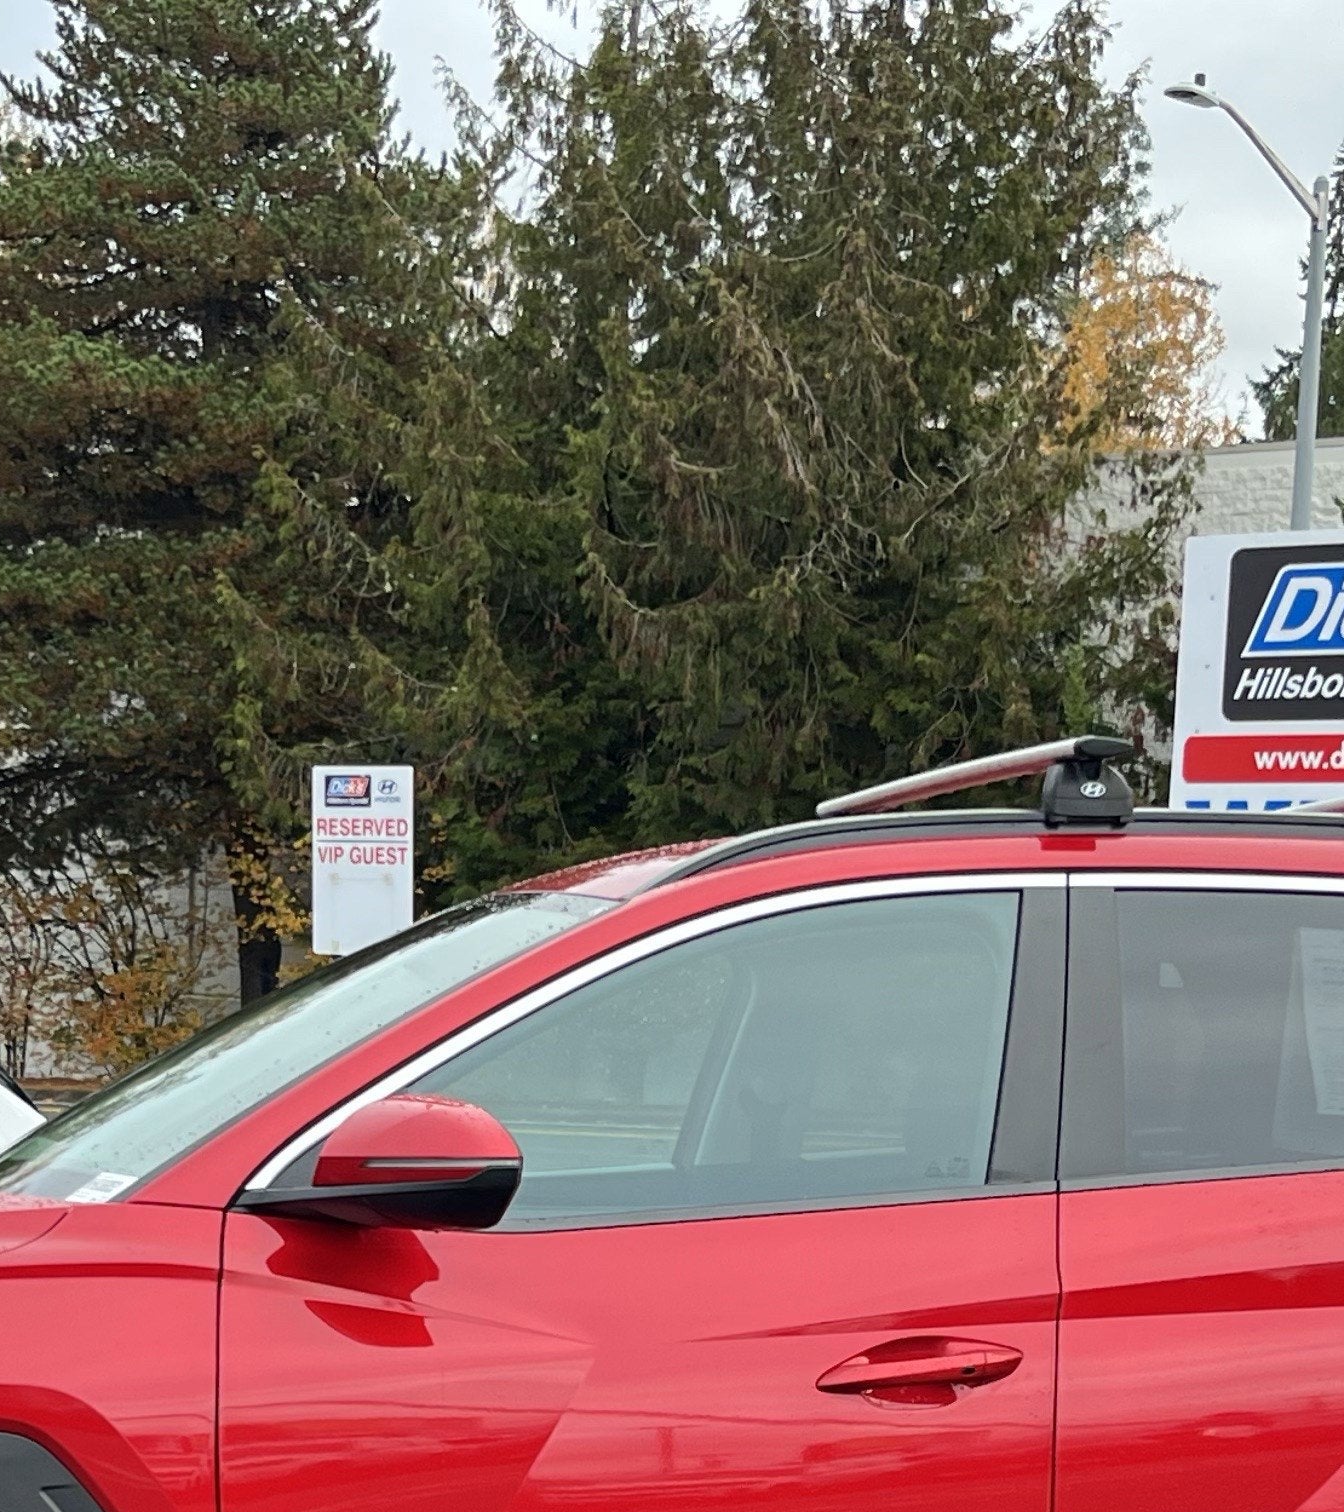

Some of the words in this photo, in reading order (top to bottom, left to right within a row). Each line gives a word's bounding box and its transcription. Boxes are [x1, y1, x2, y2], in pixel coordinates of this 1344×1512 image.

[316, 817, 409, 837] RESERVED
[317, 846, 344, 864] VIP
[349, 846, 408, 865] GUEST
